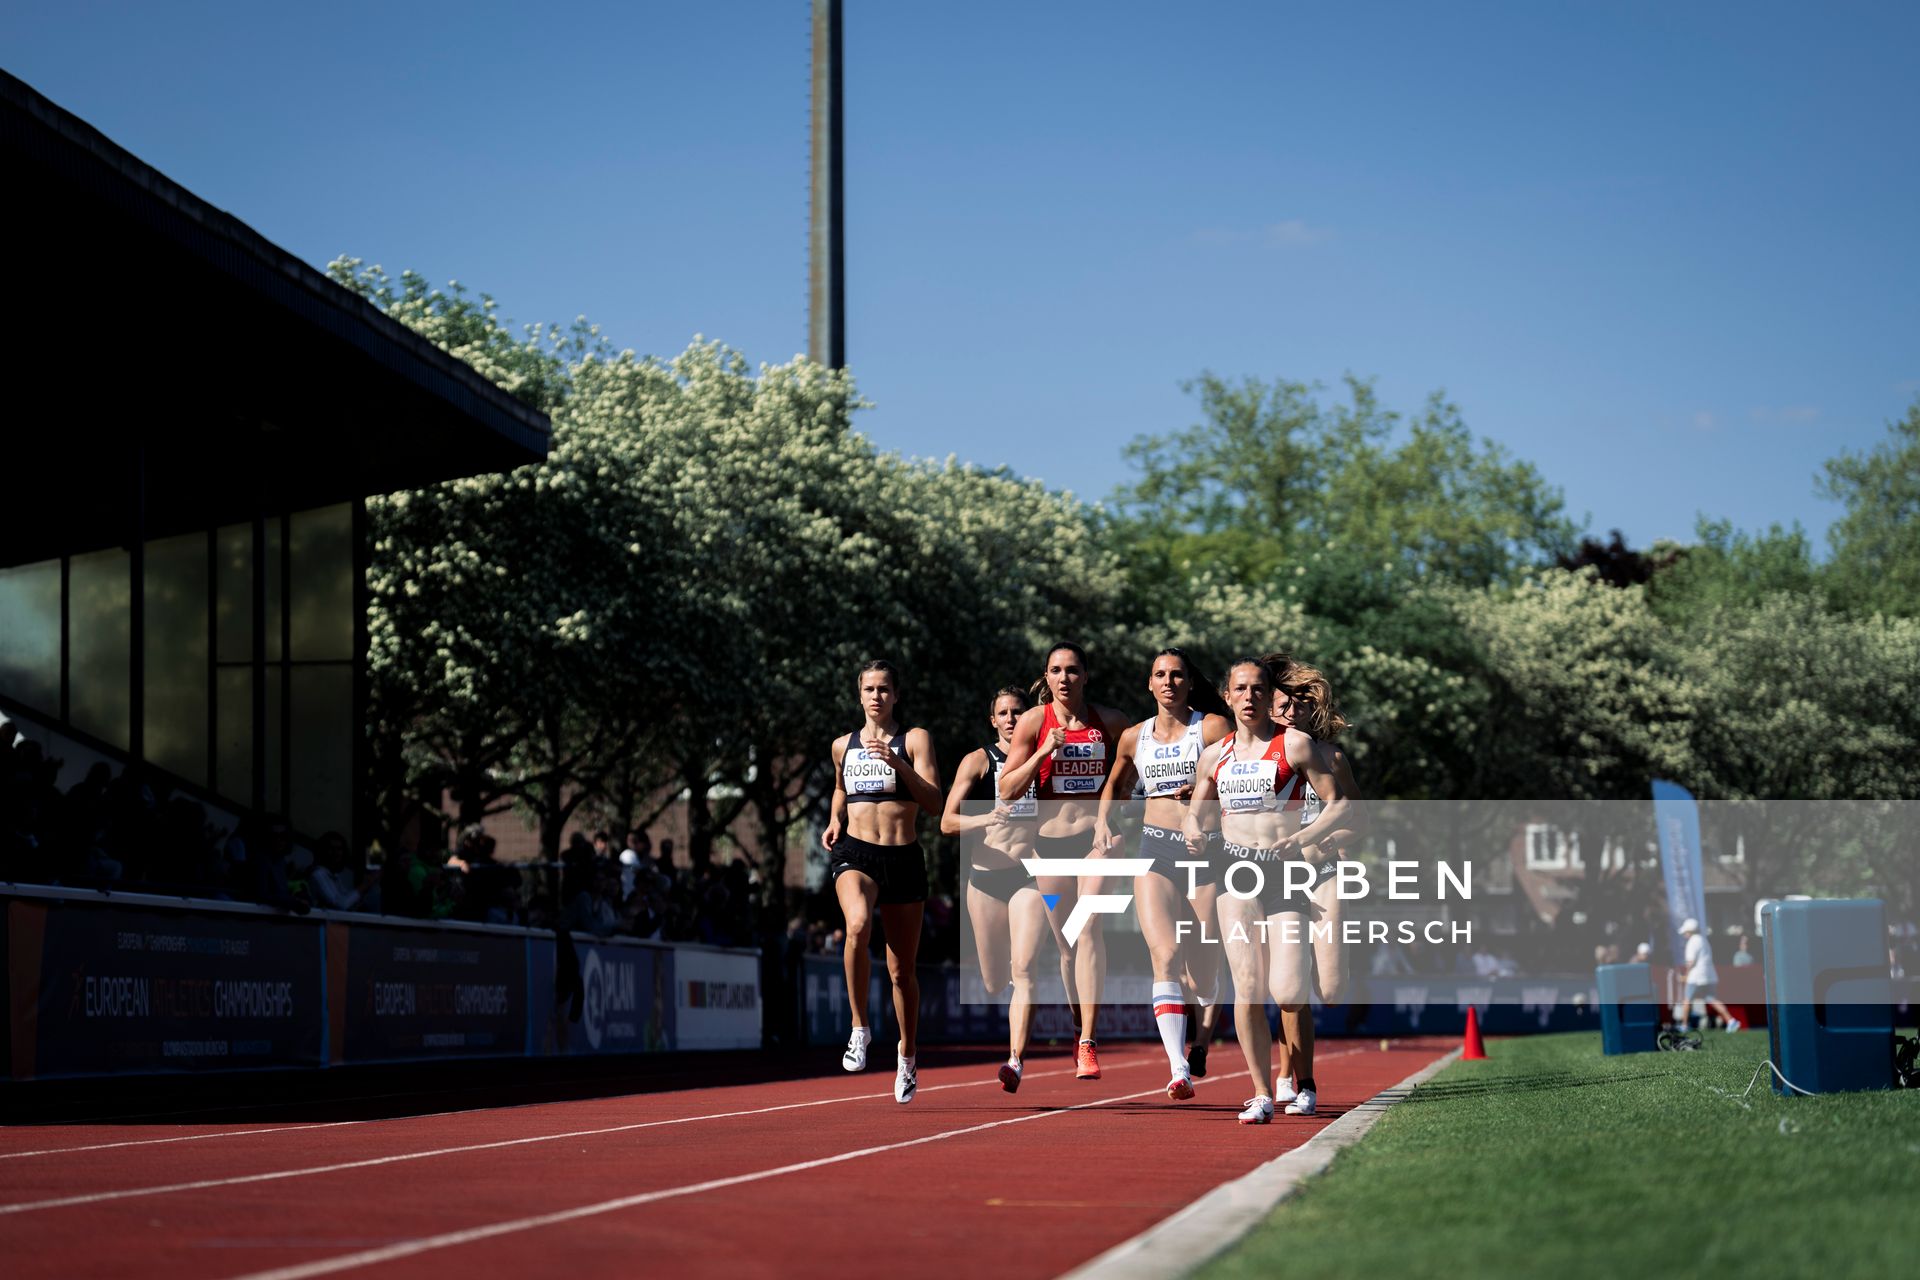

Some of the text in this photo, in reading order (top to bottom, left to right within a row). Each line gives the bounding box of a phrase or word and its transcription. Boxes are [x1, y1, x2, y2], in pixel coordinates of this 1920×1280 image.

[1063, 745, 1092, 758] GLS
[1154, 745, 1181, 760] GLS
[845, 763, 893, 777] ROSING
[1055, 761, 1104, 775] LEADER
[1144, 760, 1196, 779] OBERMAIER
[1231, 762, 1260, 775] GLS
[1220, 778, 1272, 794] CAMBOURS
[1223, 840, 1281, 861] PRO NIK
[606, 961, 635, 1011] PLAN
[86, 976, 149, 1017] EUROPEAN
[215, 980, 294, 1017] CHAMPIONSHIPS
[375, 981, 416, 1016] EUROPEAN
[455, 983, 508, 1016] CHAMPIONSHIPS
